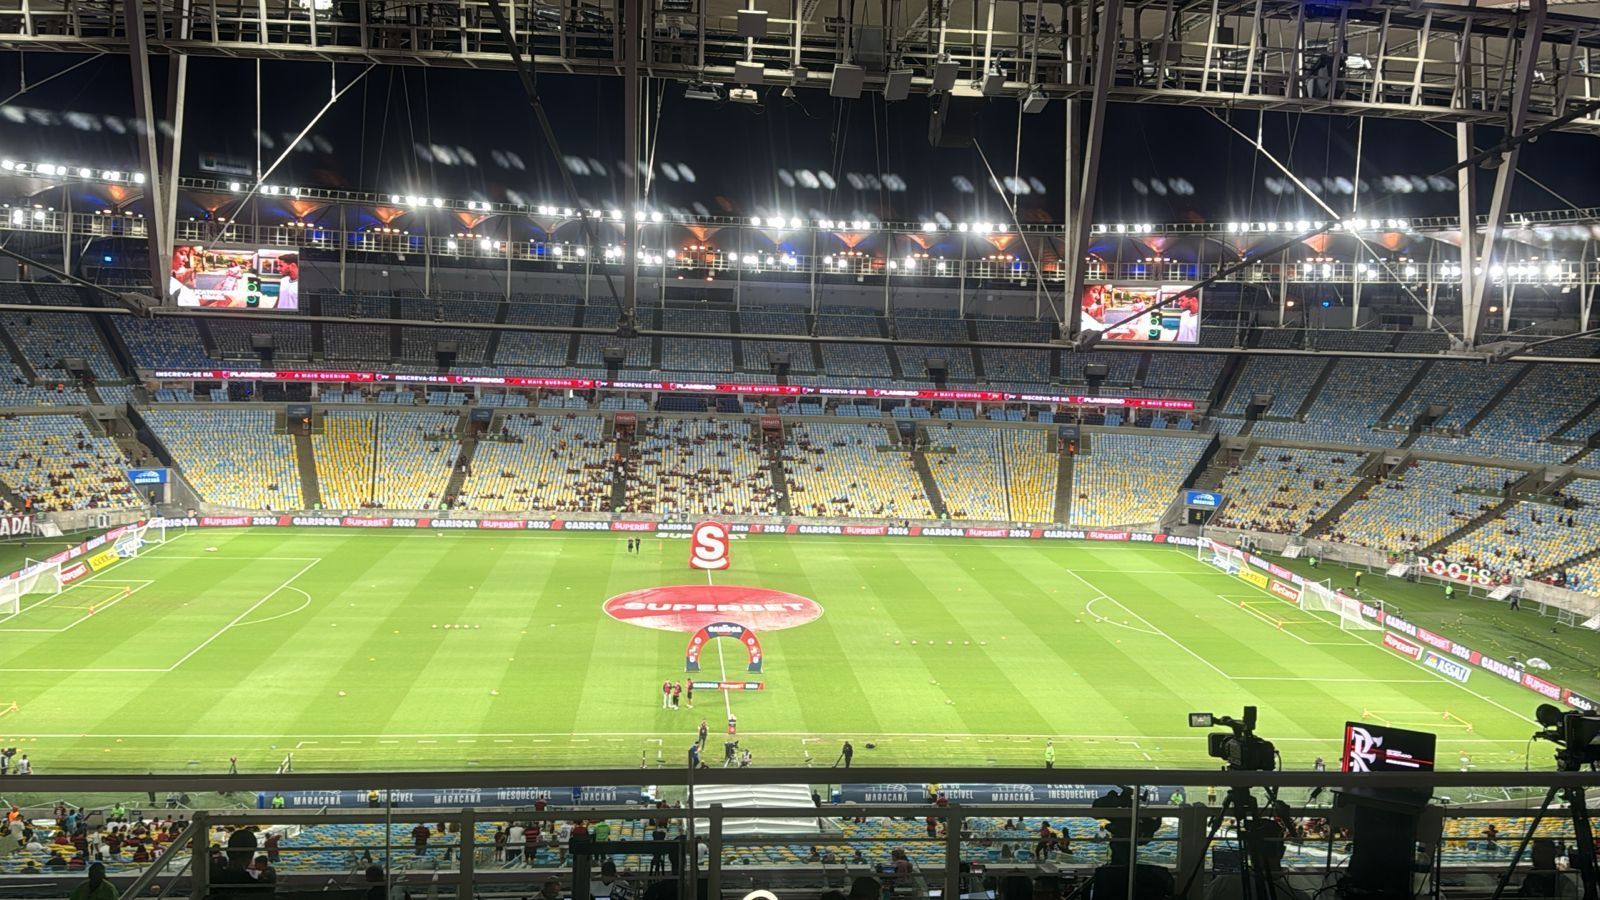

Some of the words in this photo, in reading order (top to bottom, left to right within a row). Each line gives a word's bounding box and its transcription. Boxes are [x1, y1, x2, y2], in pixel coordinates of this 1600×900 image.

[293, 518, 340, 526] CARIOCA
[346, 518, 389, 526] SUPERBET
[528, 521, 550, 529] 2026
[764, 525, 785, 533] 2026
[799, 526, 841, 534] CARIOCA
[888, 527, 908, 535] 2026
[922, 528, 964, 536] CARIOCA
[969, 529, 1007, 537] SUPERBET
[1009, 529, 1030, 537] 2026
[1044, 530, 1085, 538] CARIOCA
[1090, 531, 1129, 540] SUPERBET
[1131, 533, 1153, 541] 2026
[695, 525, 725, 560] S
[1418, 556, 1492, 585] ROOTS
[1273, 582, 1297, 600] Betano
[624, 602, 804, 612] SUPERBET
[1386, 614, 1416, 637] CARIOCA
[1384, 635, 1419, 656] SUPERBET
[1452, 643, 1470, 660] 2026
[1481, 656, 1520, 683] CARIOCA
[497, 790, 552, 800] INESQUECÍVEL
[1048, 790, 1099, 799] INESQUECÍVEL
